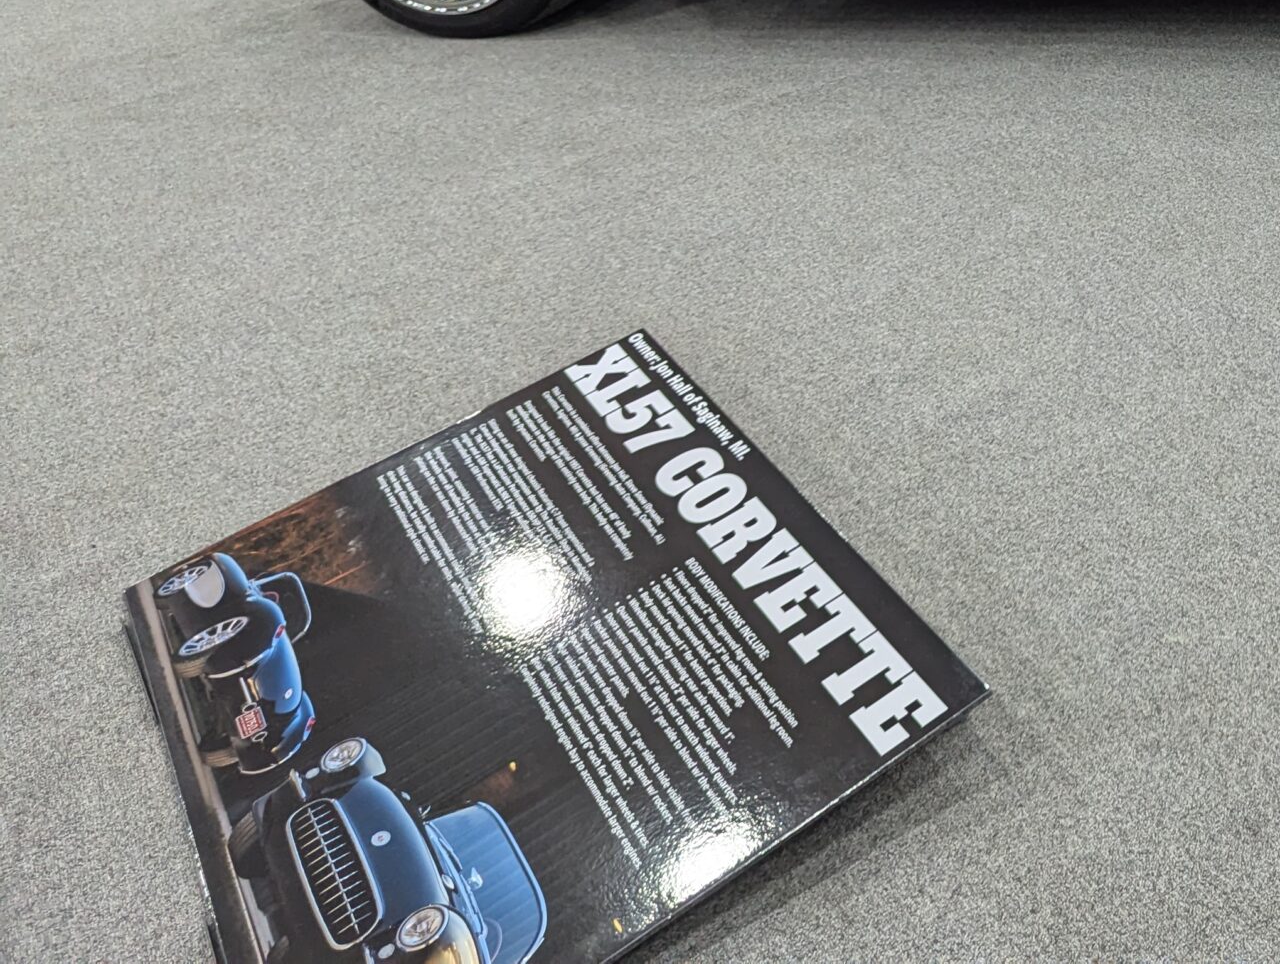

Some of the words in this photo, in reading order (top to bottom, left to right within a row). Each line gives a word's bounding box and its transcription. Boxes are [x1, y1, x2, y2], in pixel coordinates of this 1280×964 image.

[628, 333, 661, 365] Owner:
[650, 360, 673, 378] Jon
[667, 374, 693, 395] Hall
[683, 393, 703, 405] of
[691, 401, 733, 446] Saginaw,
[729, 440, 750, 460] MI.
[564, 343, 695, 453] XL57
[655, 447, 948, 756] CORVETTE
